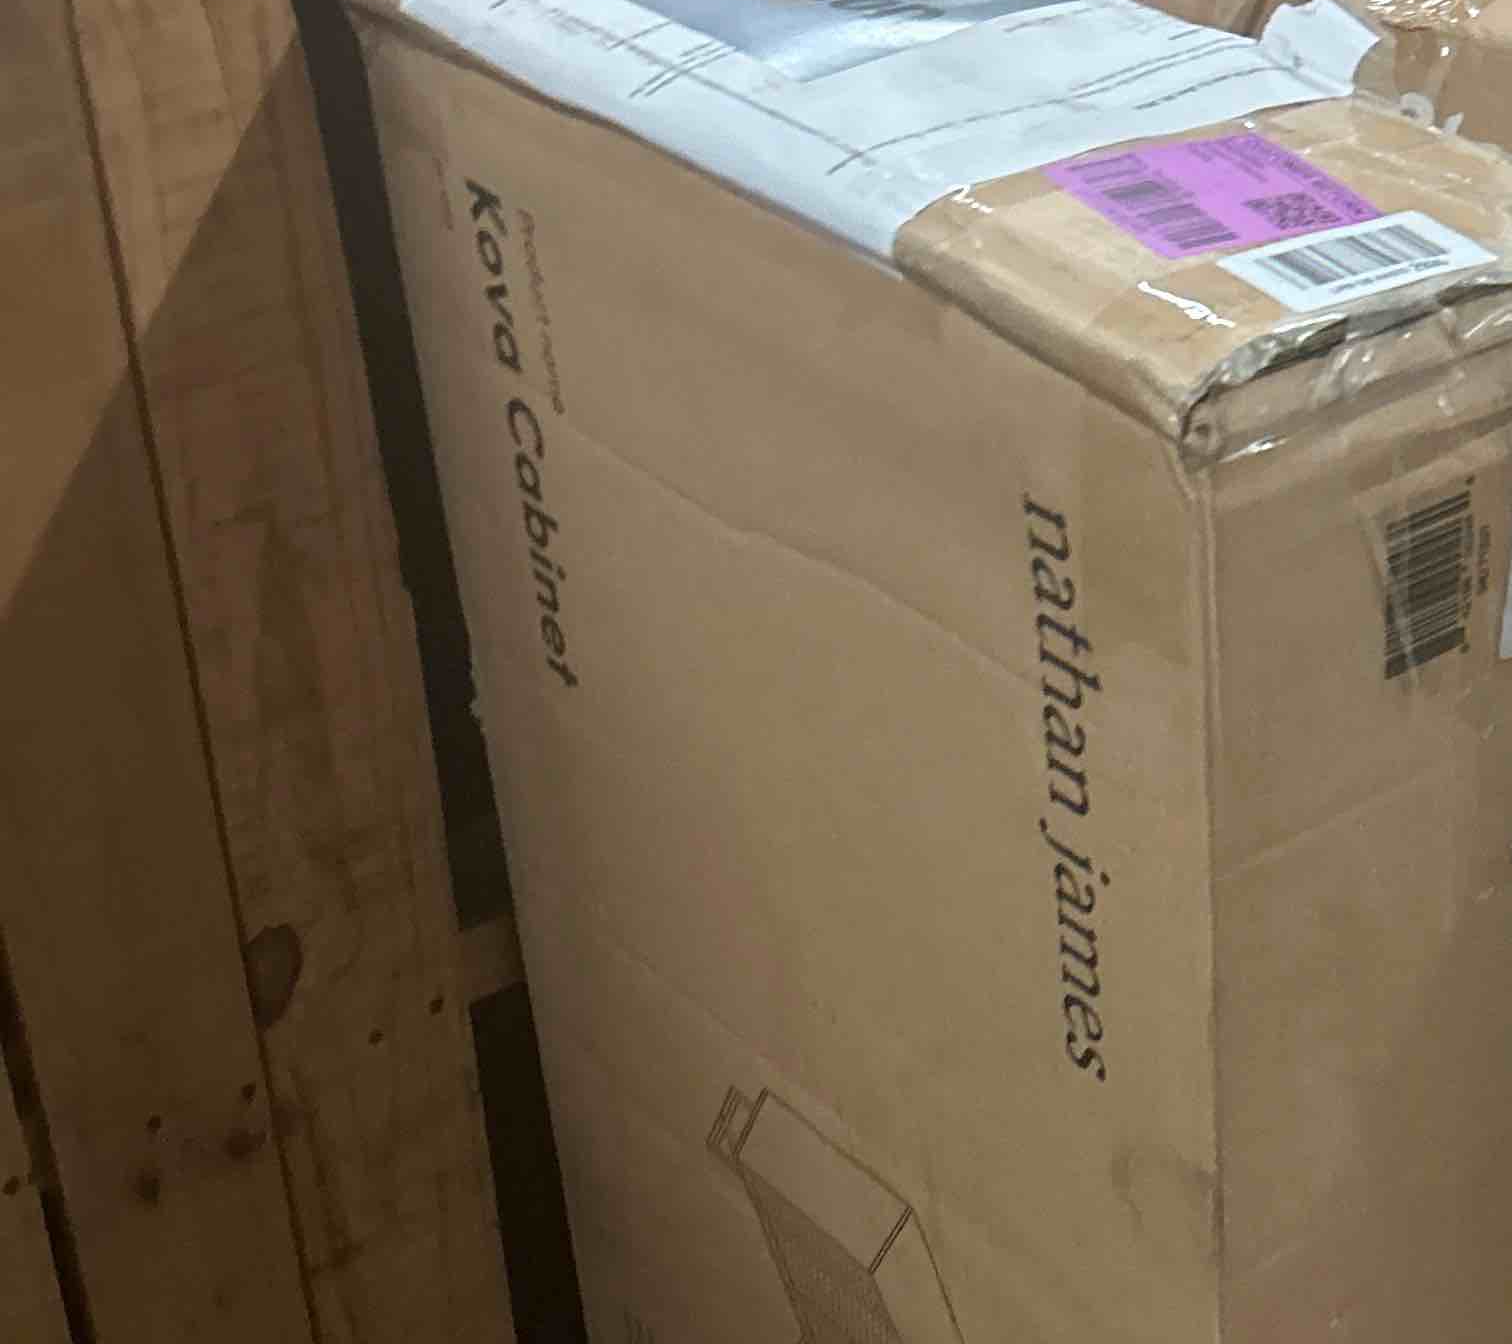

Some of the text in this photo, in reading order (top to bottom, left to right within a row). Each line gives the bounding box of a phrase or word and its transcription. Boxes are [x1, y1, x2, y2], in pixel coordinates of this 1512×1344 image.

[465, 177, 579, 690] Kova Cabinet
[1022, 491, 1112, 1083] nathan james
